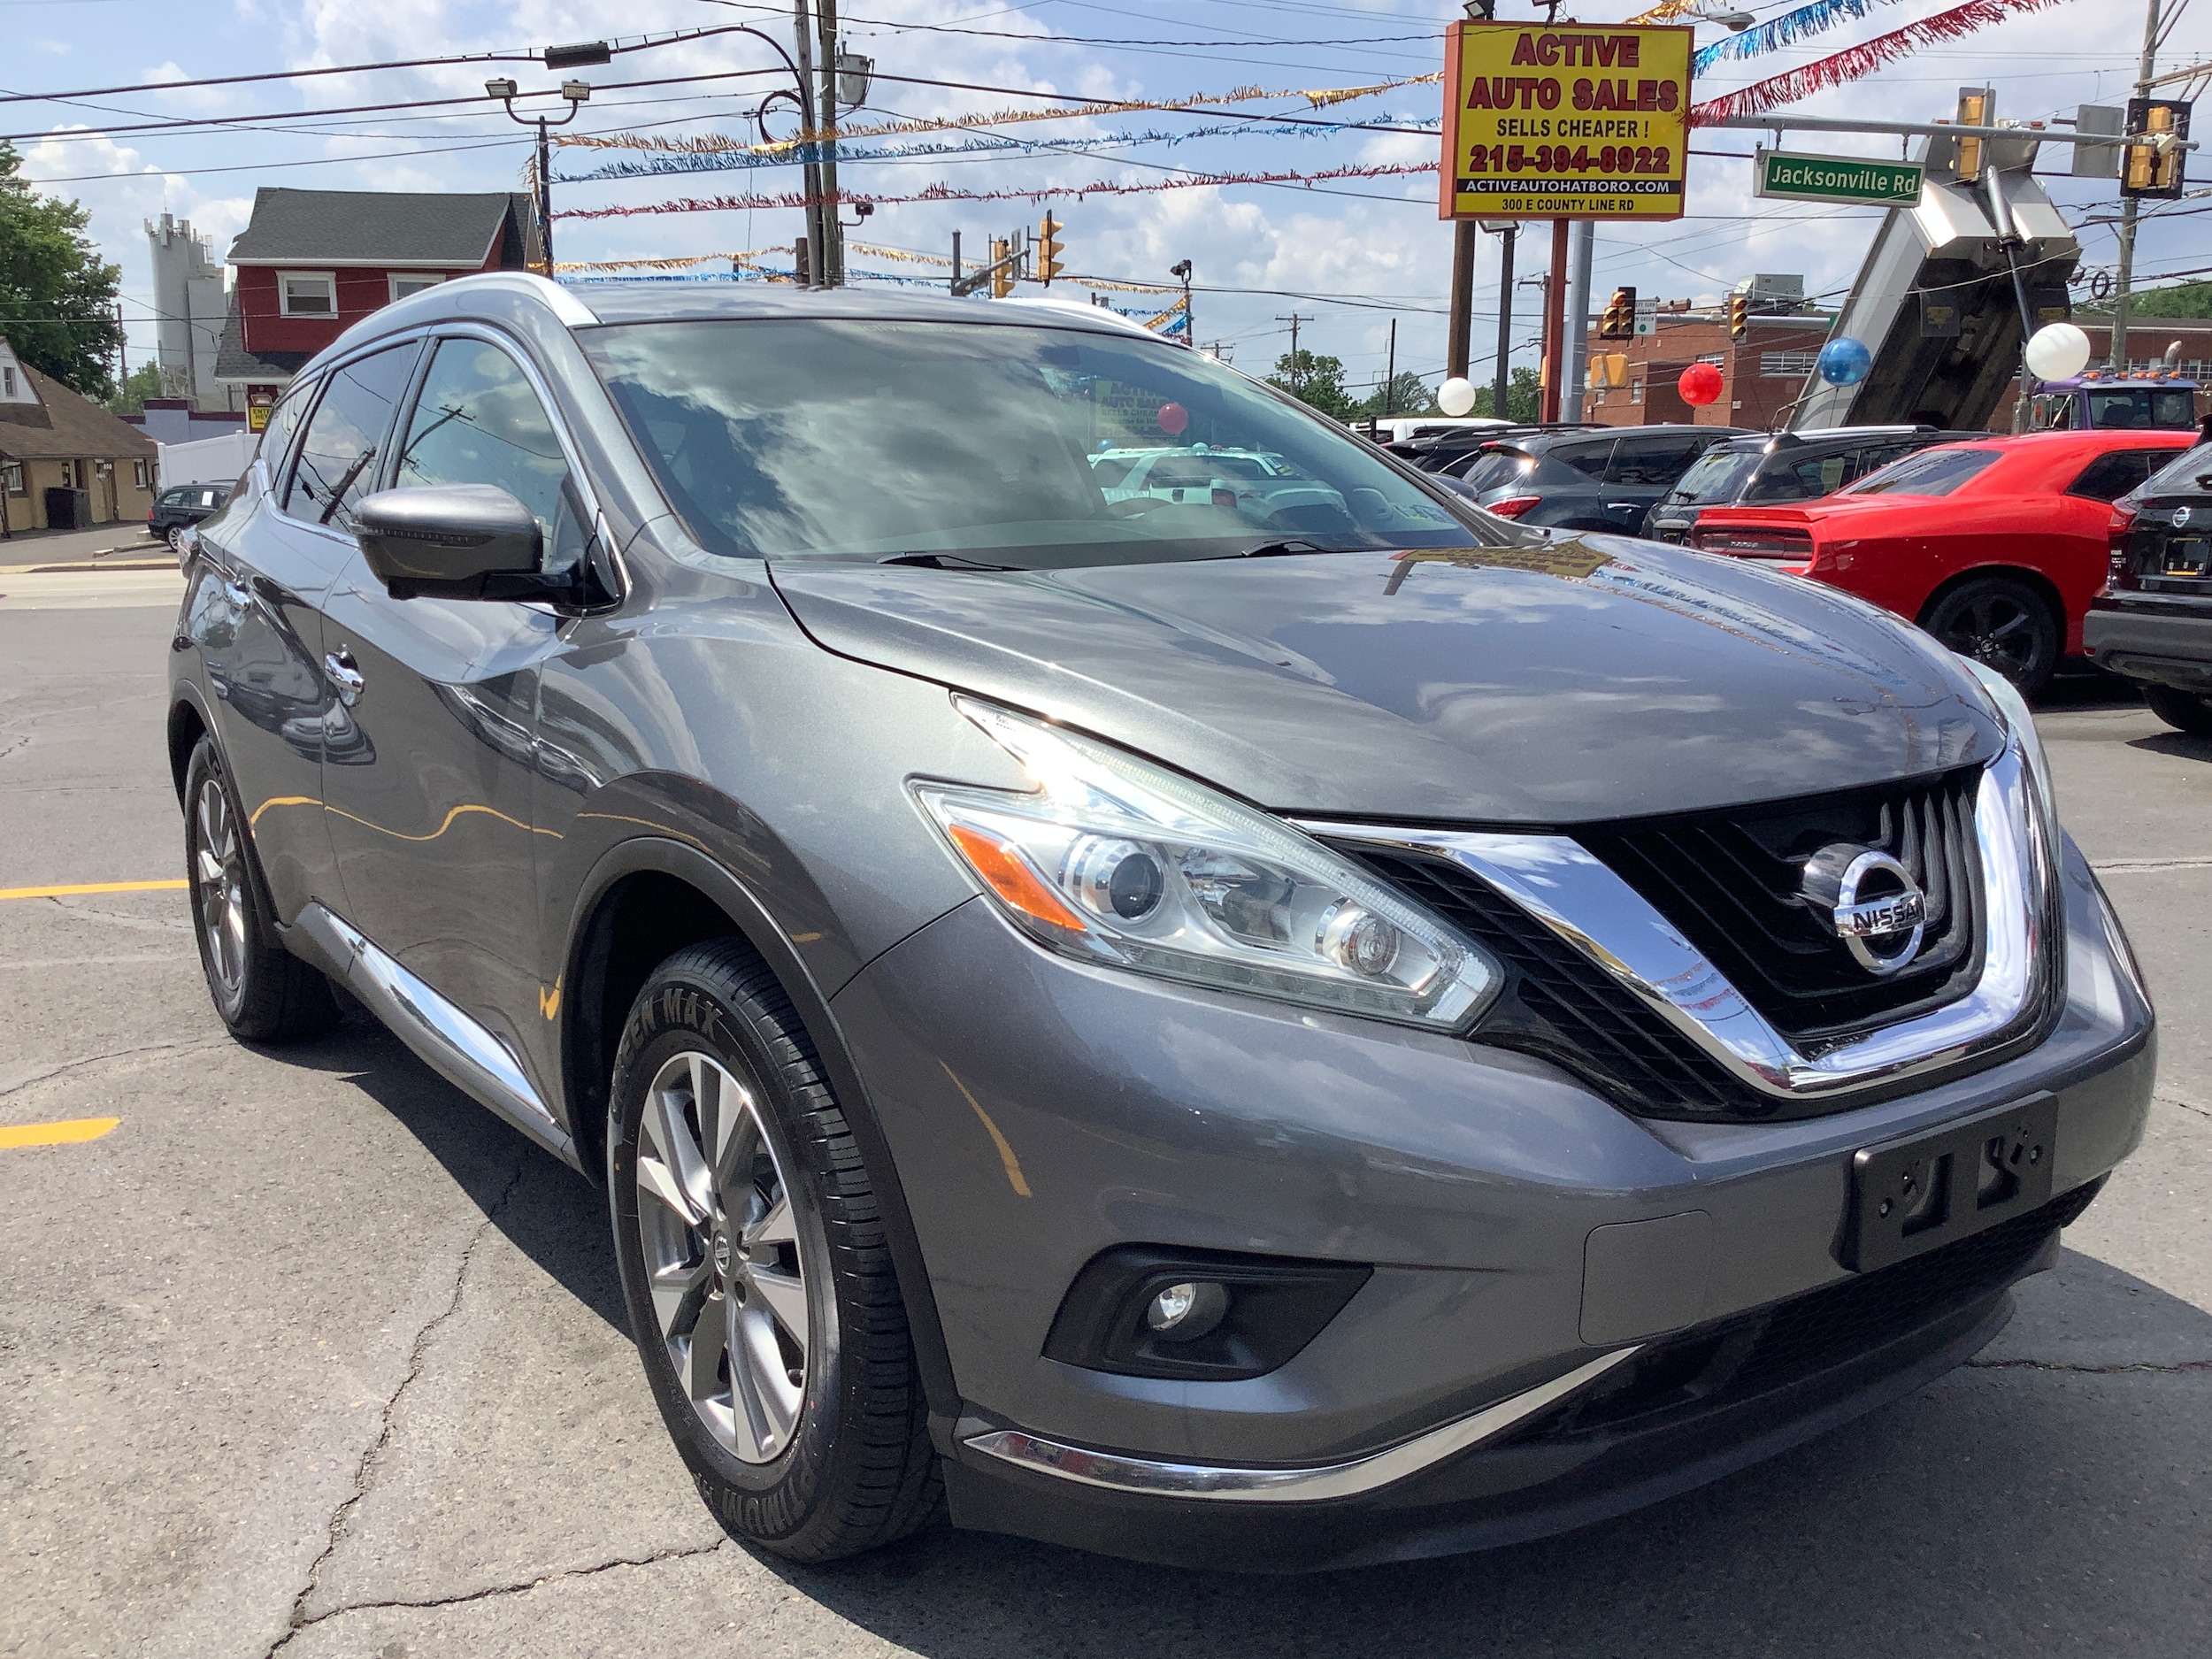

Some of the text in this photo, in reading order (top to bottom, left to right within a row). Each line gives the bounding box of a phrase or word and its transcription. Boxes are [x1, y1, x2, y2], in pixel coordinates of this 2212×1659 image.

[1510, 33, 1640, 68] ACTIVE
[1466, 76, 1678, 112] AUTO SALES
[1496, 119, 1550, 137] SELLS
[1557, 119, 1638, 138] CHEAPER
[1469, 144, 1670, 173] 215-394-8922
[1465, 180, 1670, 193] ACTIVEAUTOHATBORO.COM
[1771, 165, 1916, 193] Jacksonville Rd
[1502, 198, 1634, 211] 300 E COUNTY LINE RD
[663, 987, 723, 1041] MAX
